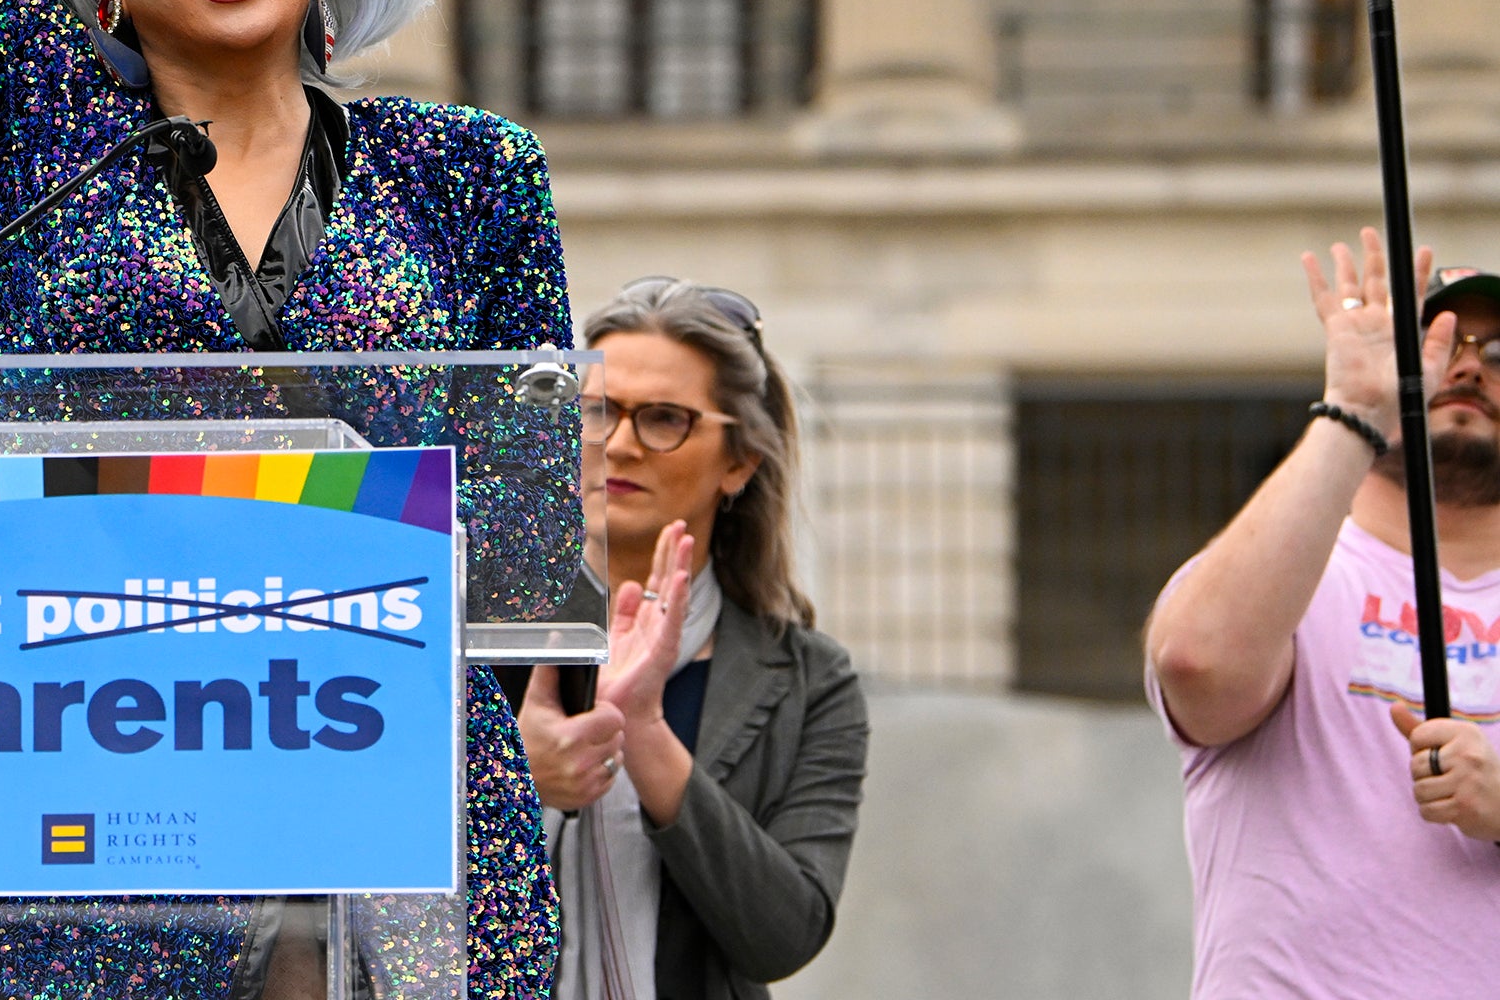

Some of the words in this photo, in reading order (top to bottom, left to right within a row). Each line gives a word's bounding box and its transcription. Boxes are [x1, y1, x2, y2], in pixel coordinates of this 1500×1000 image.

[25, 576, 422, 643] politicians
[107, 812, 197, 825] HUMAN
[107, 834, 197, 847] RIGHTS
